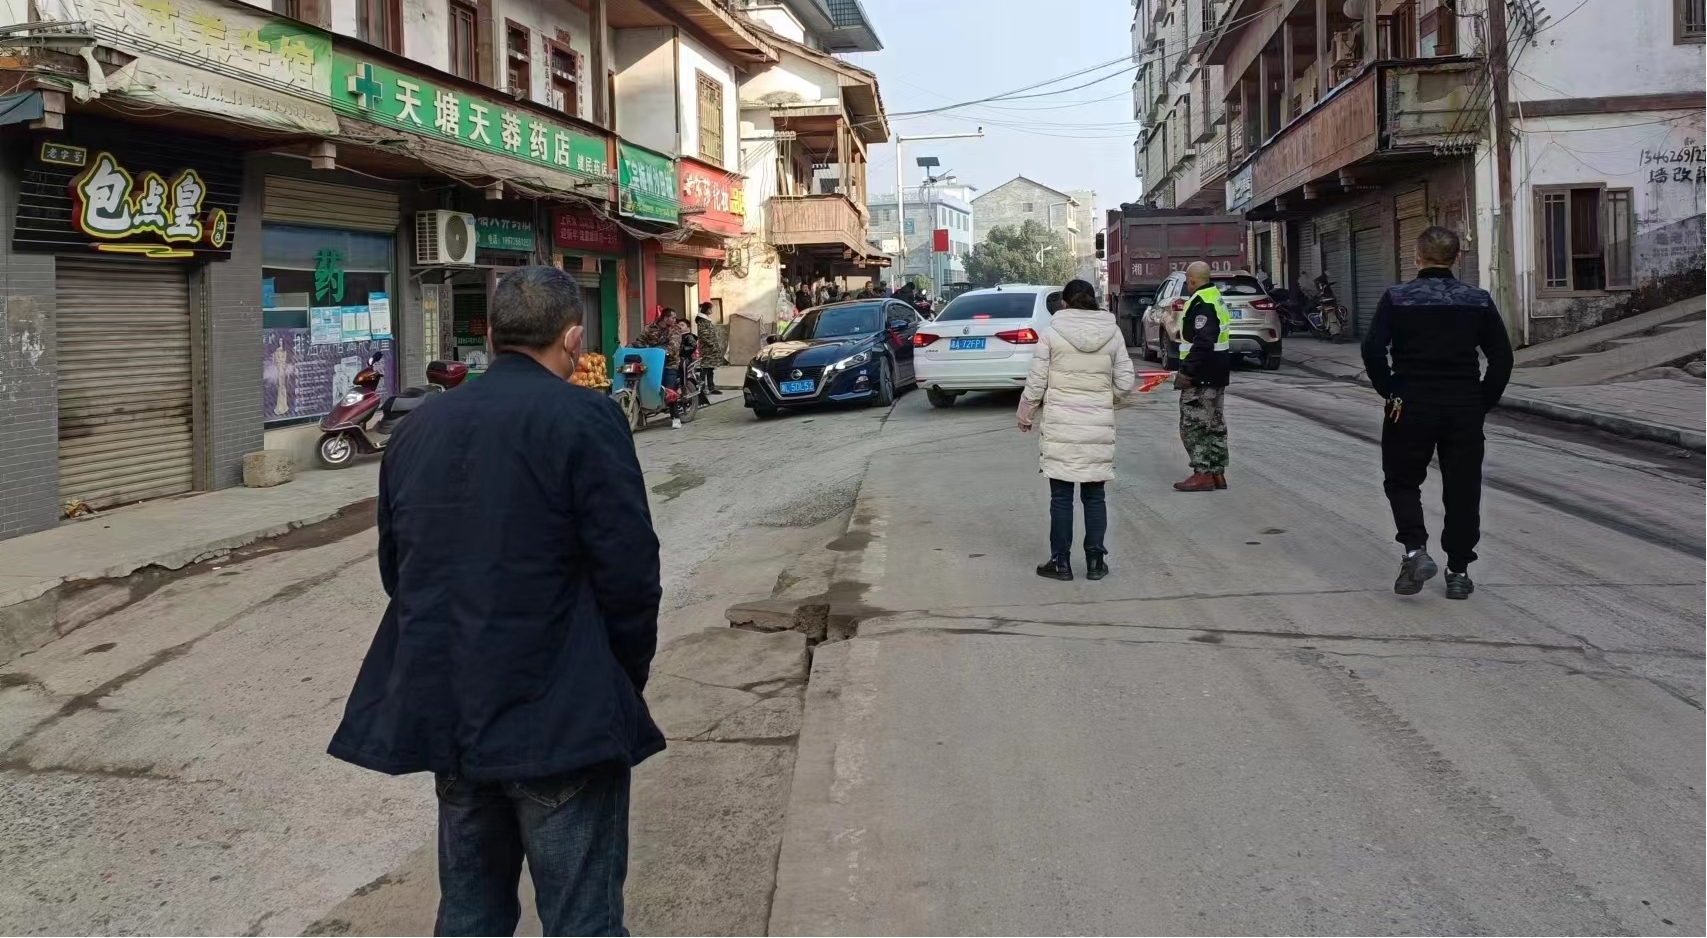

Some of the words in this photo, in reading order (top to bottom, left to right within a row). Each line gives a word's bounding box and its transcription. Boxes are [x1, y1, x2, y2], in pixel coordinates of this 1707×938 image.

[395, 79, 571, 168] 天塘天莽药店
[46, 147, 83, 162] 老字号
[577, 153, 609, 178] 健民药店
[83, 159, 202, 237] 包点皇
[312, 248, 345, 303] 药
